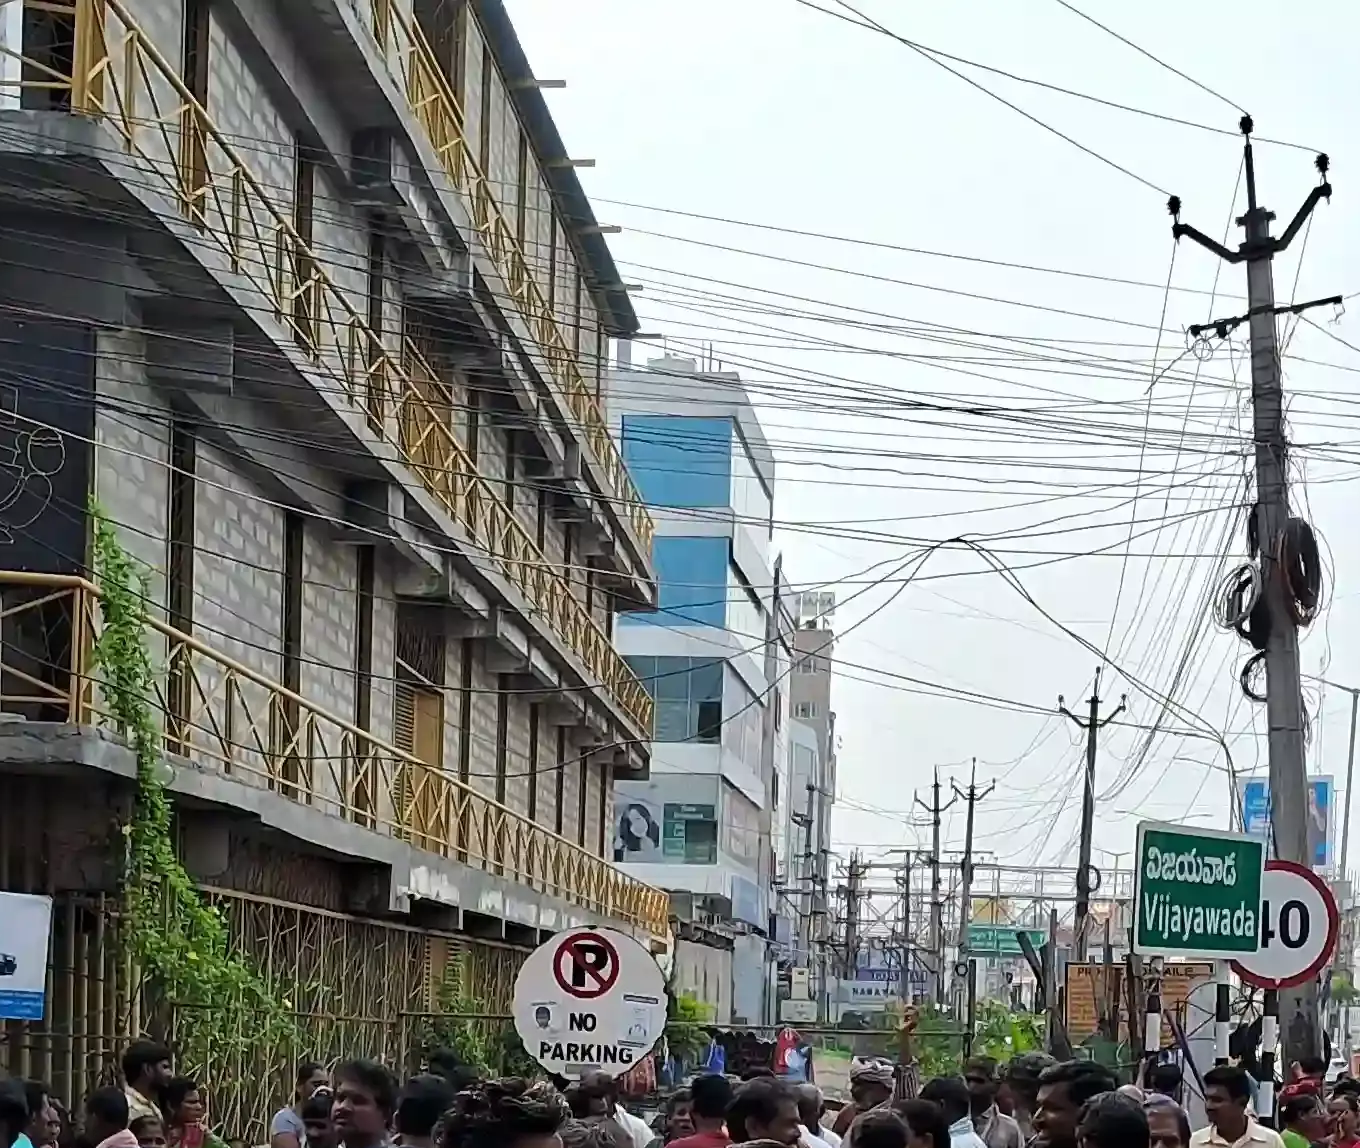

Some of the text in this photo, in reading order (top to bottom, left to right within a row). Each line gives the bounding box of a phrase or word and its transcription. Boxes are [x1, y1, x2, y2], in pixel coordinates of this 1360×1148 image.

[1146, 847, 1237, 886] విజయవాడ
[1144, 892, 1255, 942] Vijayawada
[568, 1012, 597, 1032] NO
[539, 1041, 633, 1064] PARKING
